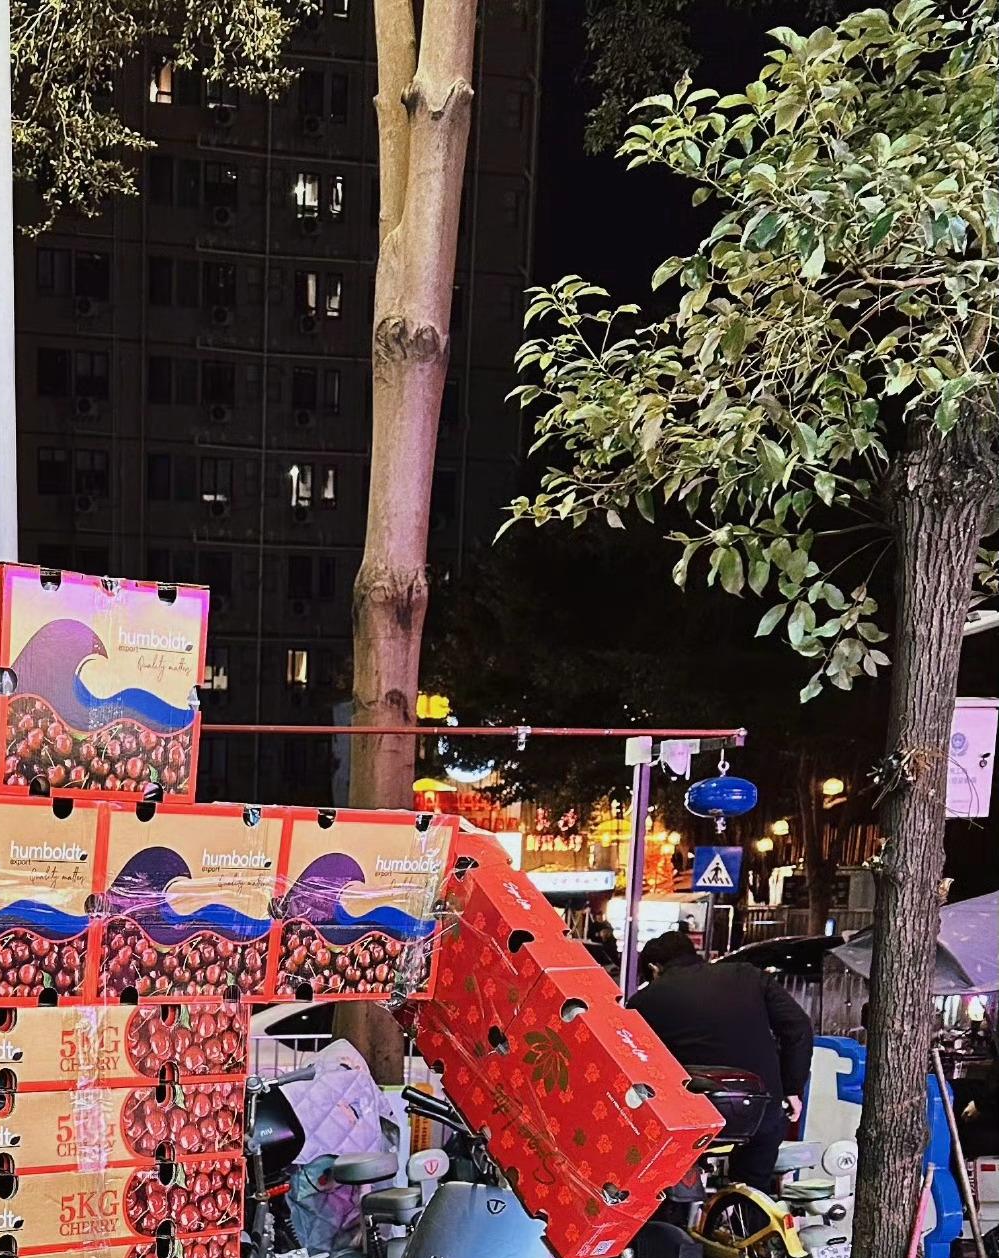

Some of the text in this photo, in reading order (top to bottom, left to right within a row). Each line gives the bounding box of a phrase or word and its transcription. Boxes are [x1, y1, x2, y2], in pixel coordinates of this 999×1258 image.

[118, 627, 193, 651] humboldt
[10, 840, 88, 861] humboldt
[202, 848, 271, 868] humboldt
[10, 858, 31, 866] export
[375, 855, 441, 873] humboldt
[60, 1190, 118, 1221] 5KG
[59, 1217, 118, 1236] CHERRY
